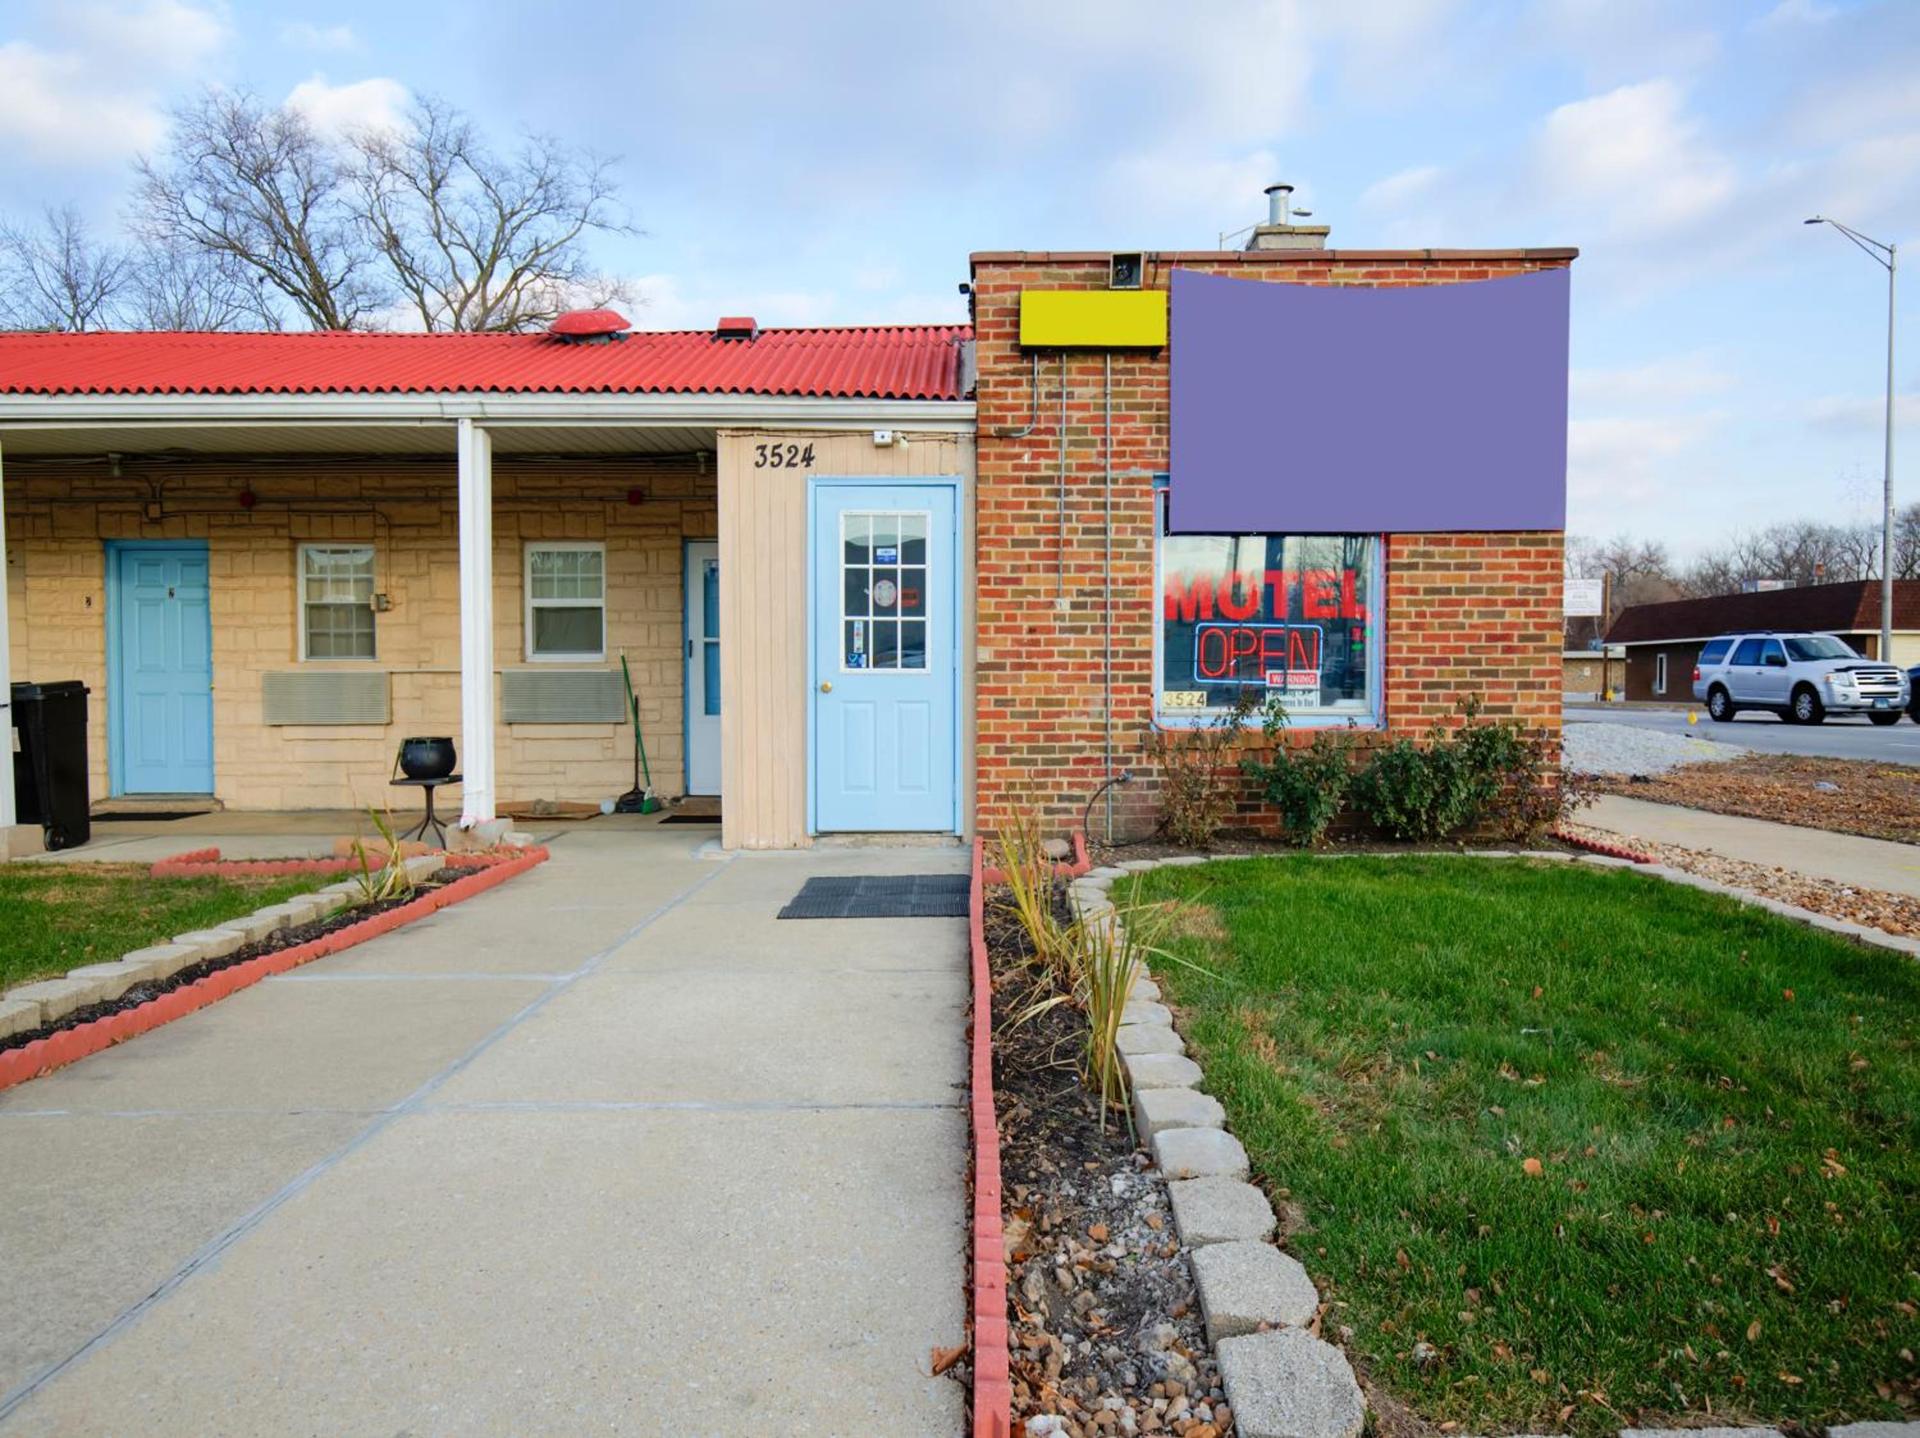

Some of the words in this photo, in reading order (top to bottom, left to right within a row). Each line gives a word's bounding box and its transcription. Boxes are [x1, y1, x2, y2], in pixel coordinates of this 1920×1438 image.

[754, 443, 815, 468] 3524
[1164, 569, 1366, 621] MOTEL
[1200, 628, 1318, 677] OPEN
[1165, 692, 1205, 706] 3524
